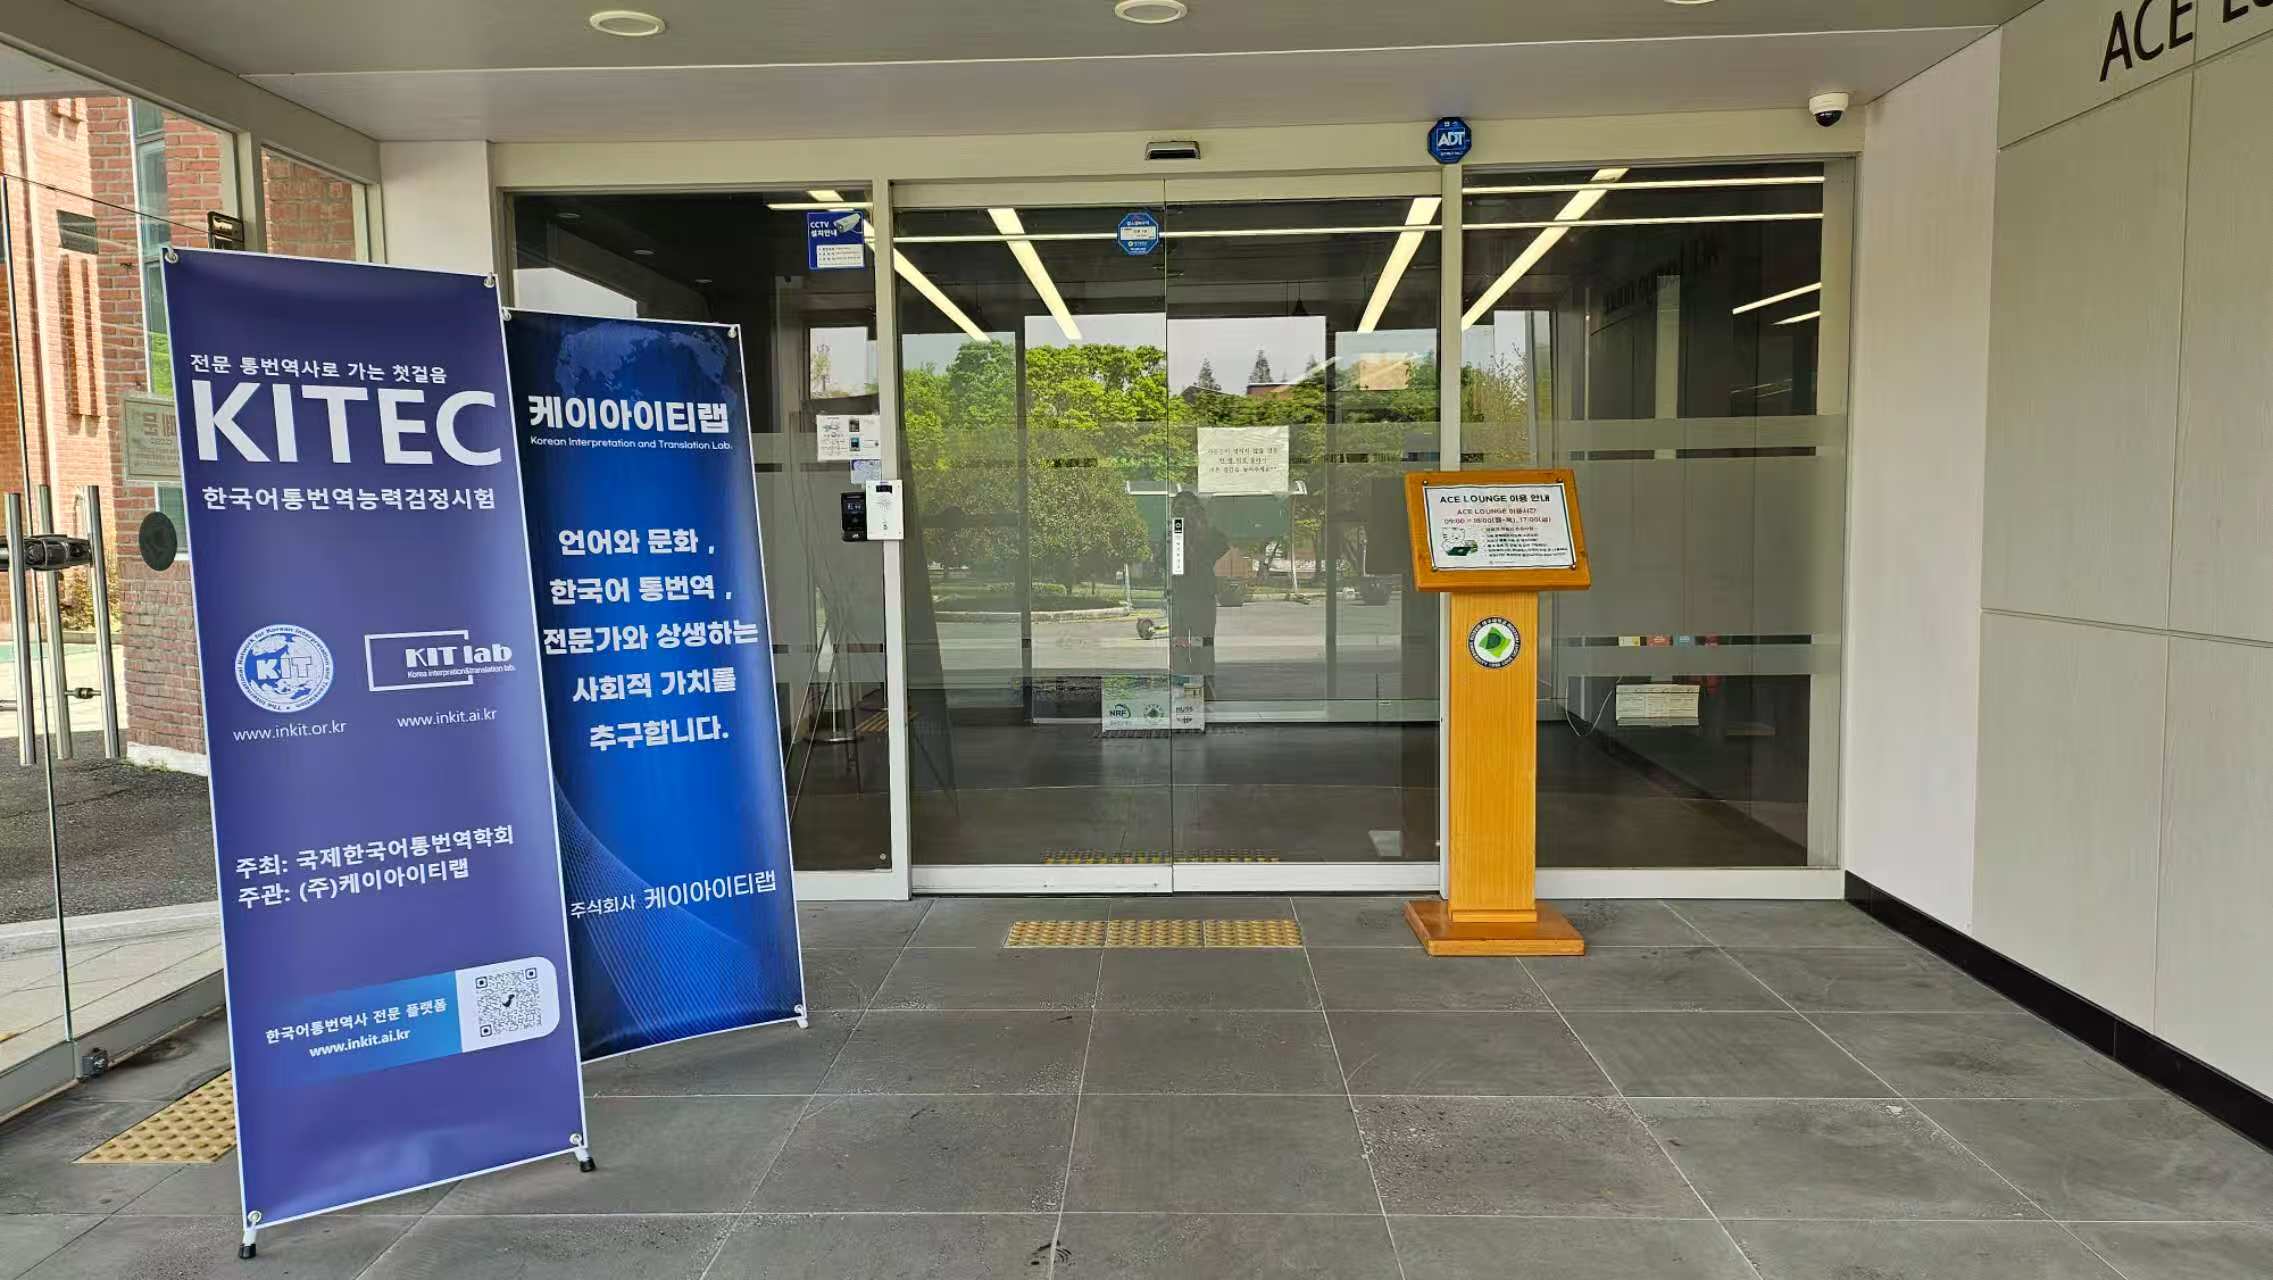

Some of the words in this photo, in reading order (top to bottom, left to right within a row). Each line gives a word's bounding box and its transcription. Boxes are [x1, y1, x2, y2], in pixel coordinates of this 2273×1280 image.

[2100, 0, 2194, 82] ACE
[1438, 131, 1465, 147] ADT
[190, 354, 231, 374] 전문
[239, 356, 340, 378] 통번역사로
[348, 362, 385, 381] 가는
[392, 364, 447, 384] 첫걸음
[192, 380, 502, 466] KITEC
[528, 395, 729, 433] 케이아이티랩
[530, 436, 566, 446] Korean
[568, 437, 636, 449] Interpretation
[638, 438, 656, 449] and
[658, 439, 709, 450] Translation
[202, 486, 496, 511] 한국어통번역능력검정시험
[1440, 495, 1460, 504] ACE
[1463, 494, 1507, 503] LOUNGE
[1509, 494, 1527, 502] 이용
[1531, 493, 1550, 503] 안내
[1474, 507, 1507, 515] LOUNGE
[558, 529, 640, 555] 언어와
[648, 528, 699, 553] 문화
[550, 577, 630, 605] 한국어
[639, 575, 715, 602] 통번역
[543, 624, 648, 655] 전문가와
[656, 619, 759, 649] 상생하는
[256, 656, 312, 680] KIT
[405, 647, 458, 668] KIT
[463, 643, 513, 664] lab
[573, 672, 652, 703] 사회적
[661, 666, 736, 696] 가치를
[396, 707, 498, 727] www.inkit.ai.kr
[1109, 709, 1127, 717] NRF
[233, 720, 347, 742] www.inkit.or.kr
[590, 715, 729, 751] 추구합니다.
[235, 855, 288, 880] 주최:
[295, 824, 513, 871] 국제한국어통번역학회
[238, 883, 290, 909] 주관:
[299, 857, 470, 903] (주)케이아이티랩
[570, 895, 635, 919] 주식회사
[643, 870, 777, 910] 케이아이티랩
[265, 1012, 369, 1045] 한국어통번역사
[373, 1007, 401, 1024] 전문
[405, 997, 448, 1019] 플랫폼
[308, 1028, 410, 1057] www.inkit.ai.kr
